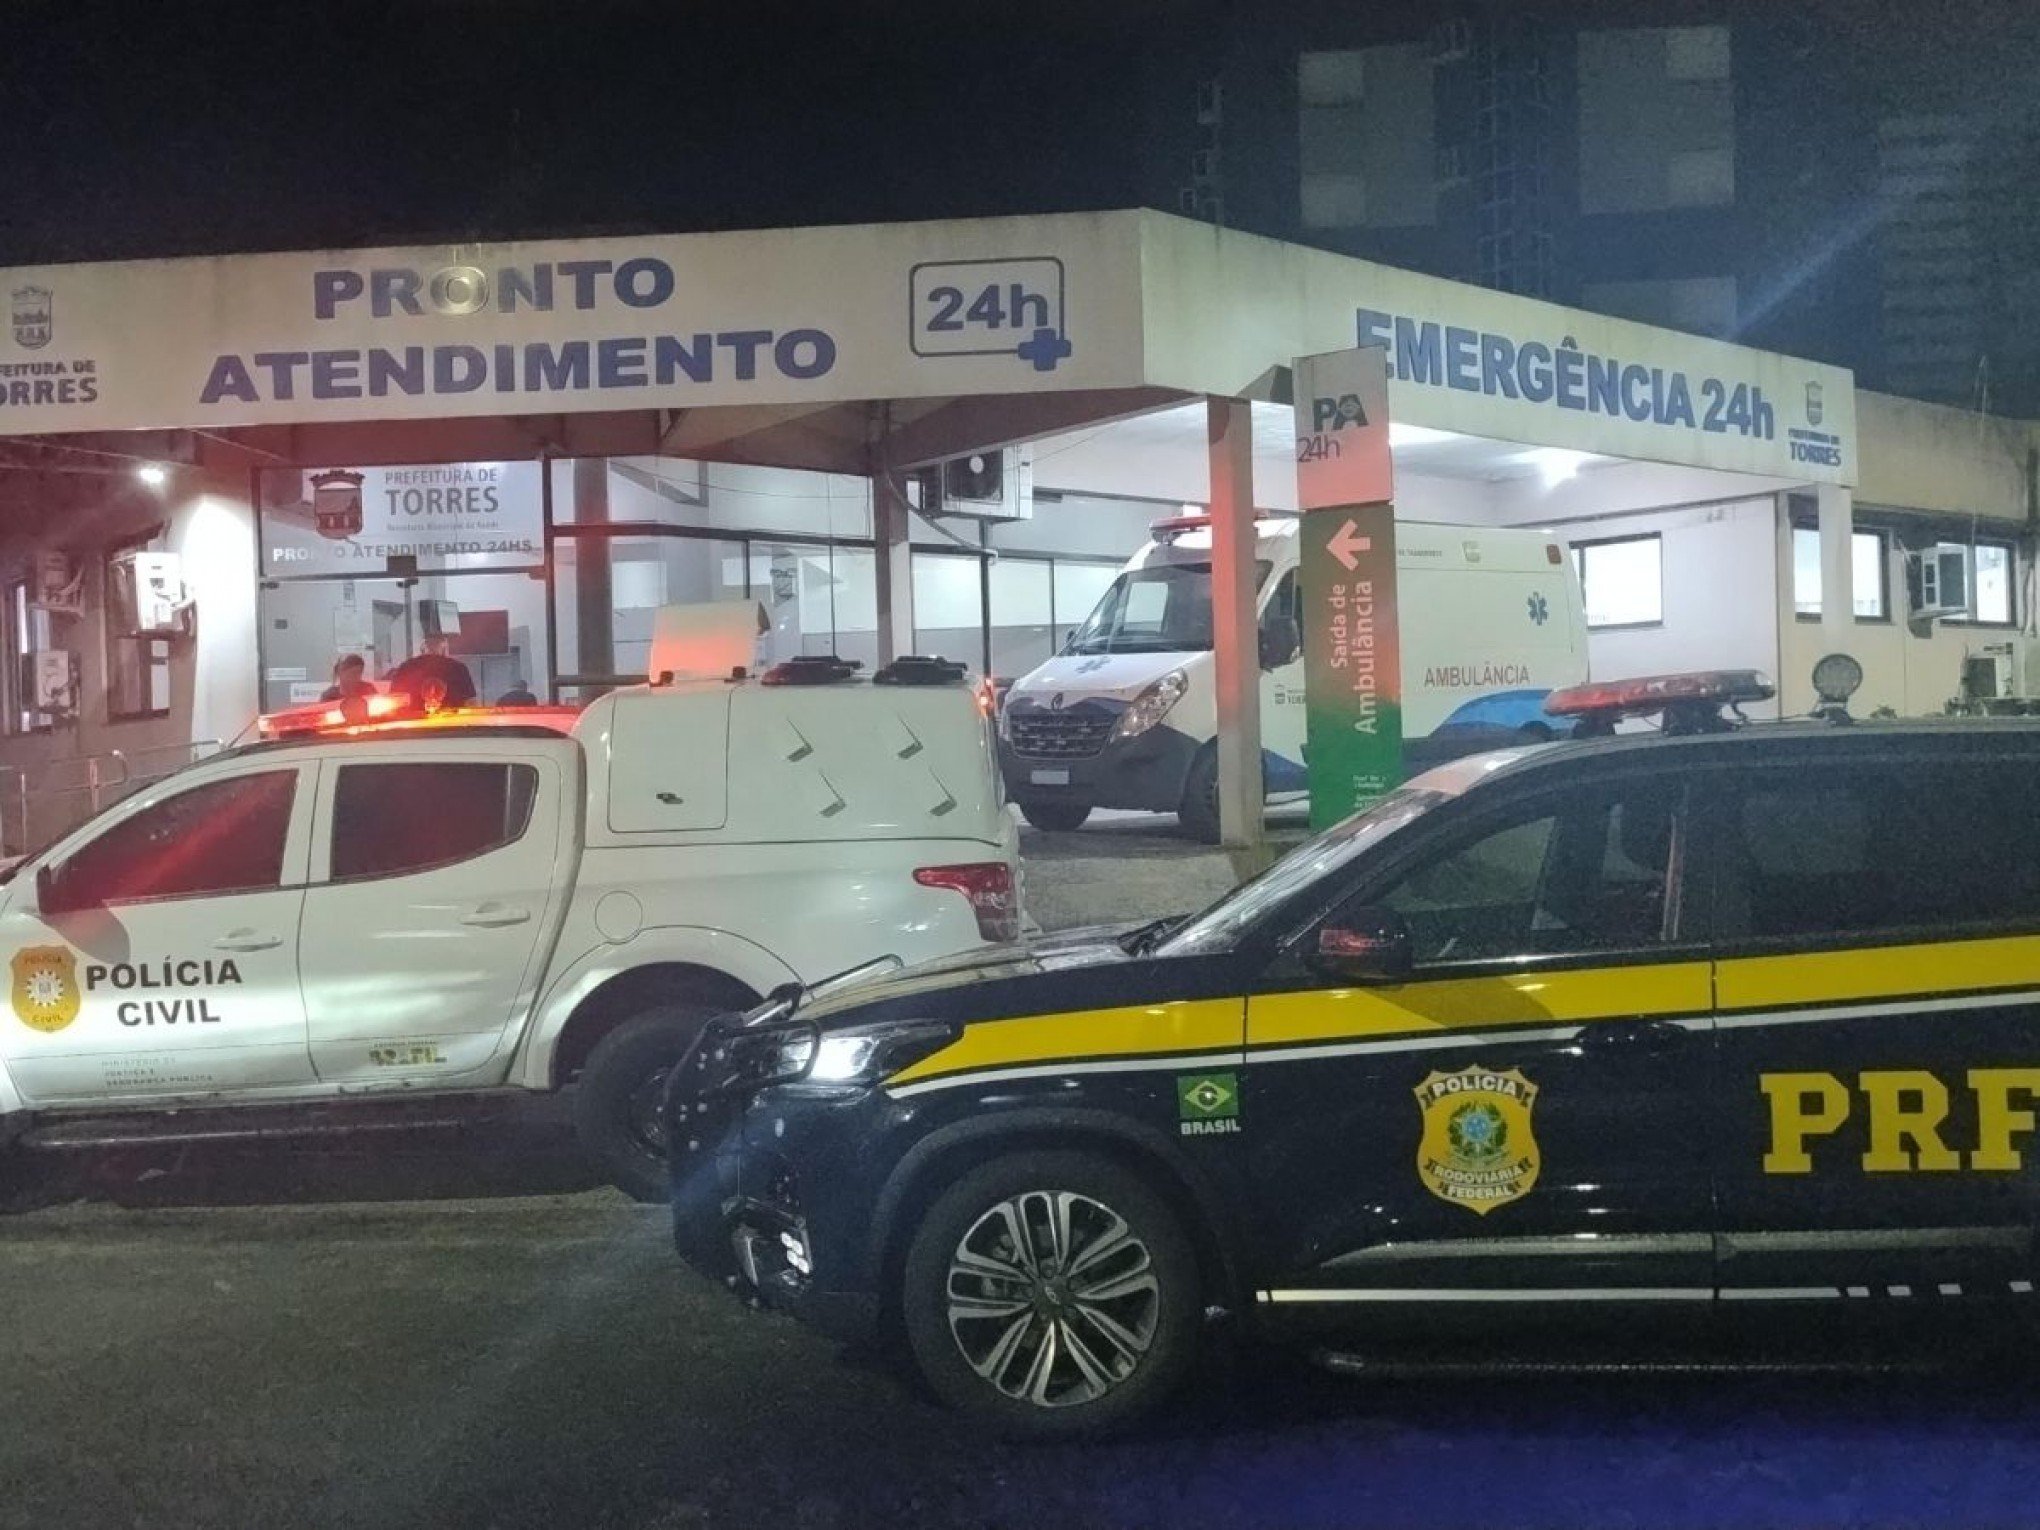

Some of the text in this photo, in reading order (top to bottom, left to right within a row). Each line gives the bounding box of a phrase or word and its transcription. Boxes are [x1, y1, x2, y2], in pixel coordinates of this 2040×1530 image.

[314, 257, 675, 320] PRONTO
[926, 284, 1049, 332] 24h
[0, 359, 96, 377] EITURA DE
[200, 329, 837, 404] ATENDIMENTO
[1356, 307, 1775, 440] EMERGÊNCIA 24h
[1313, 394, 1369, 432] PA
[1297, 435, 1341, 463] 24h
[385, 468, 498, 484] PREFEITURA DE
[385, 486, 500, 516] TORRES
[352, 540, 483, 560] ATENDIMENTO
[1328, 583, 1349, 669] Saída de
[1350, 580, 1378, 736] Ambulância
[1424, 660, 1531, 689] AMBULÂNCIA
[86, 957, 244, 991] POLÍCIA
[116, 1000, 222, 1027] CIVIL
[1181, 1119, 1241, 1136] BRASIL
[1759, 1068, 2040, 1174] PRF
[1447, 1186, 1514, 1199] FEDERAL
